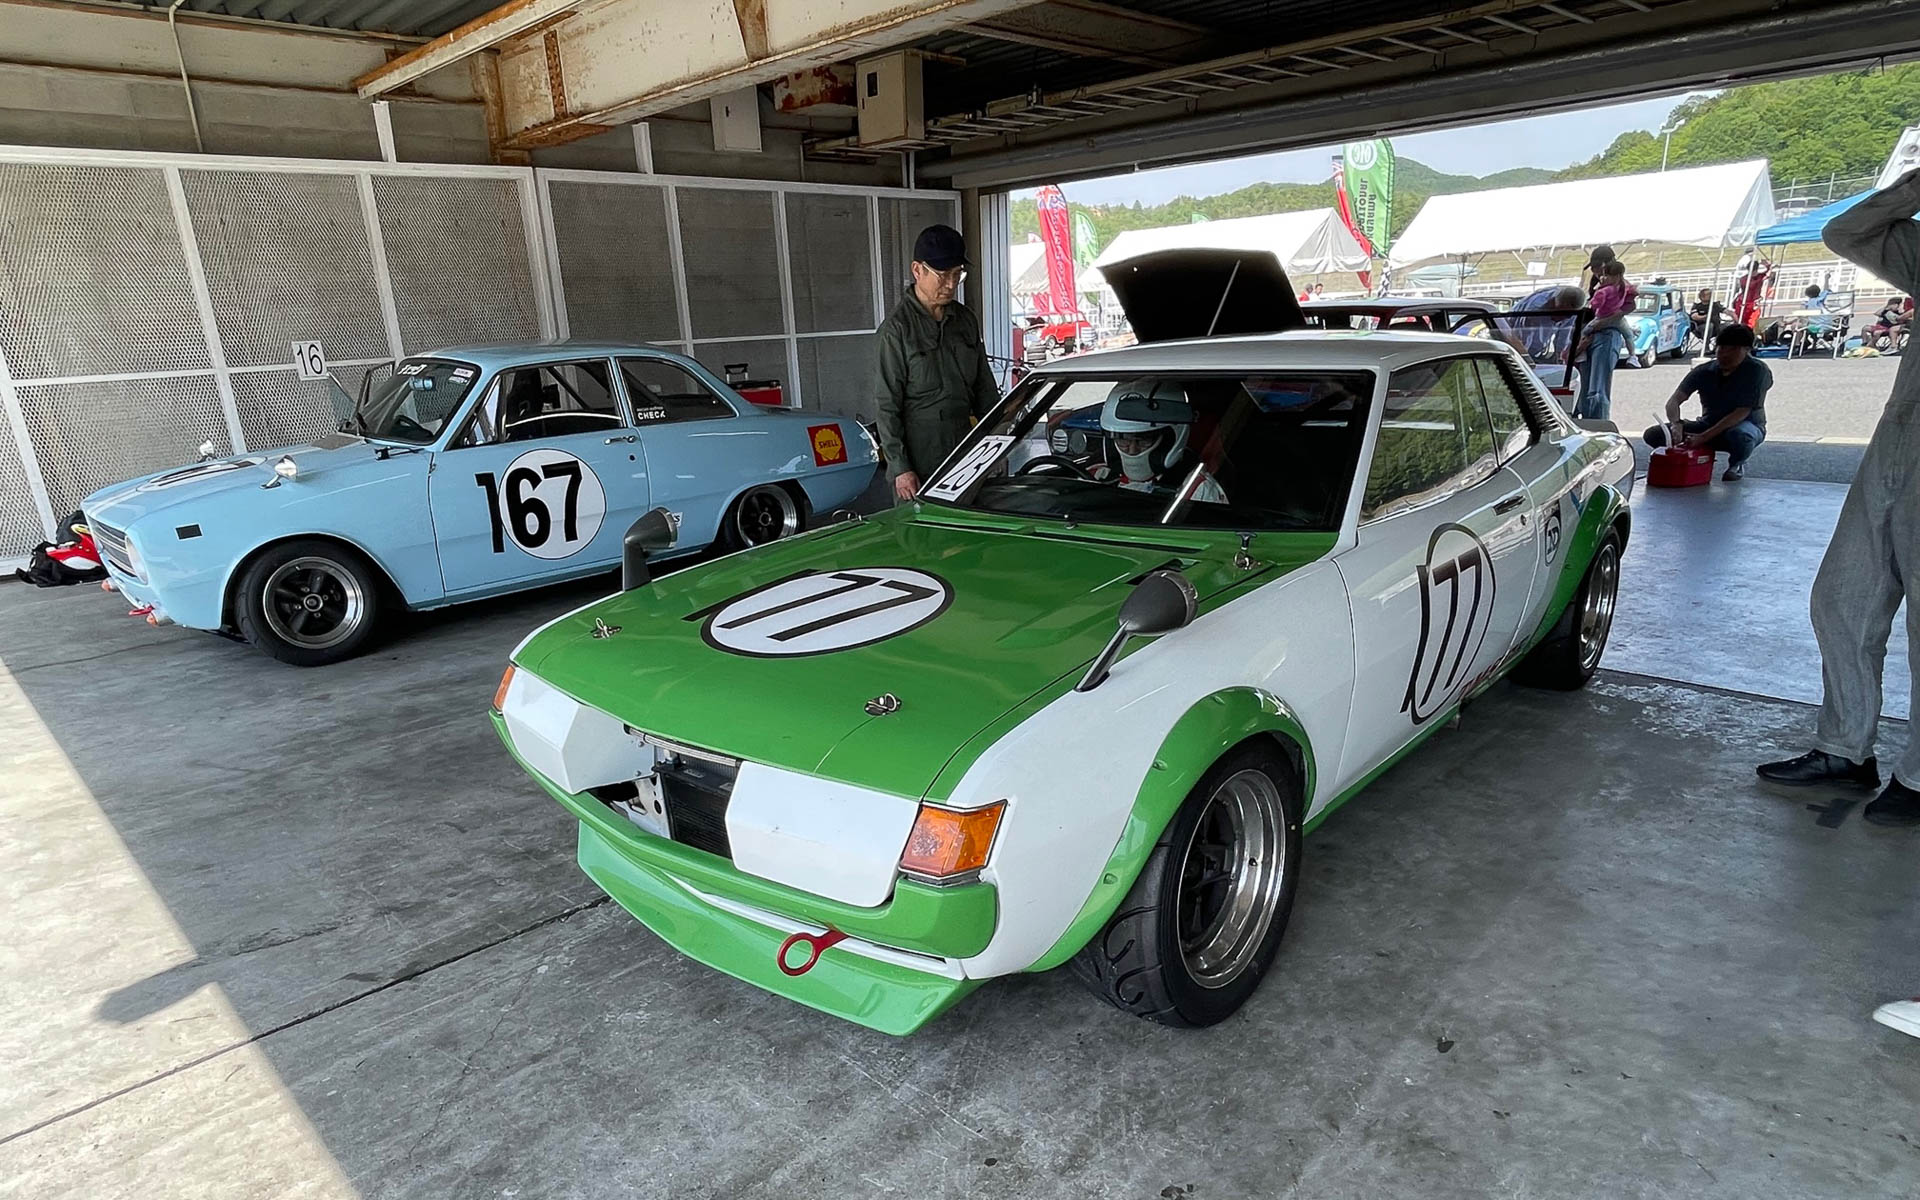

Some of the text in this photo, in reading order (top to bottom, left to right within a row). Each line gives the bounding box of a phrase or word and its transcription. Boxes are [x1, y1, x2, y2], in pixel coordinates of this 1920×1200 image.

[297, 344, 323, 375] 16
[637, 410, 666, 420] CHECK
[818, 439, 839, 449] SHELL
[936, 442, 1003, 491] 23
[474, 459, 583, 553] 167
[681, 568, 942, 642] 177
[1400, 546, 1483, 713] 177
